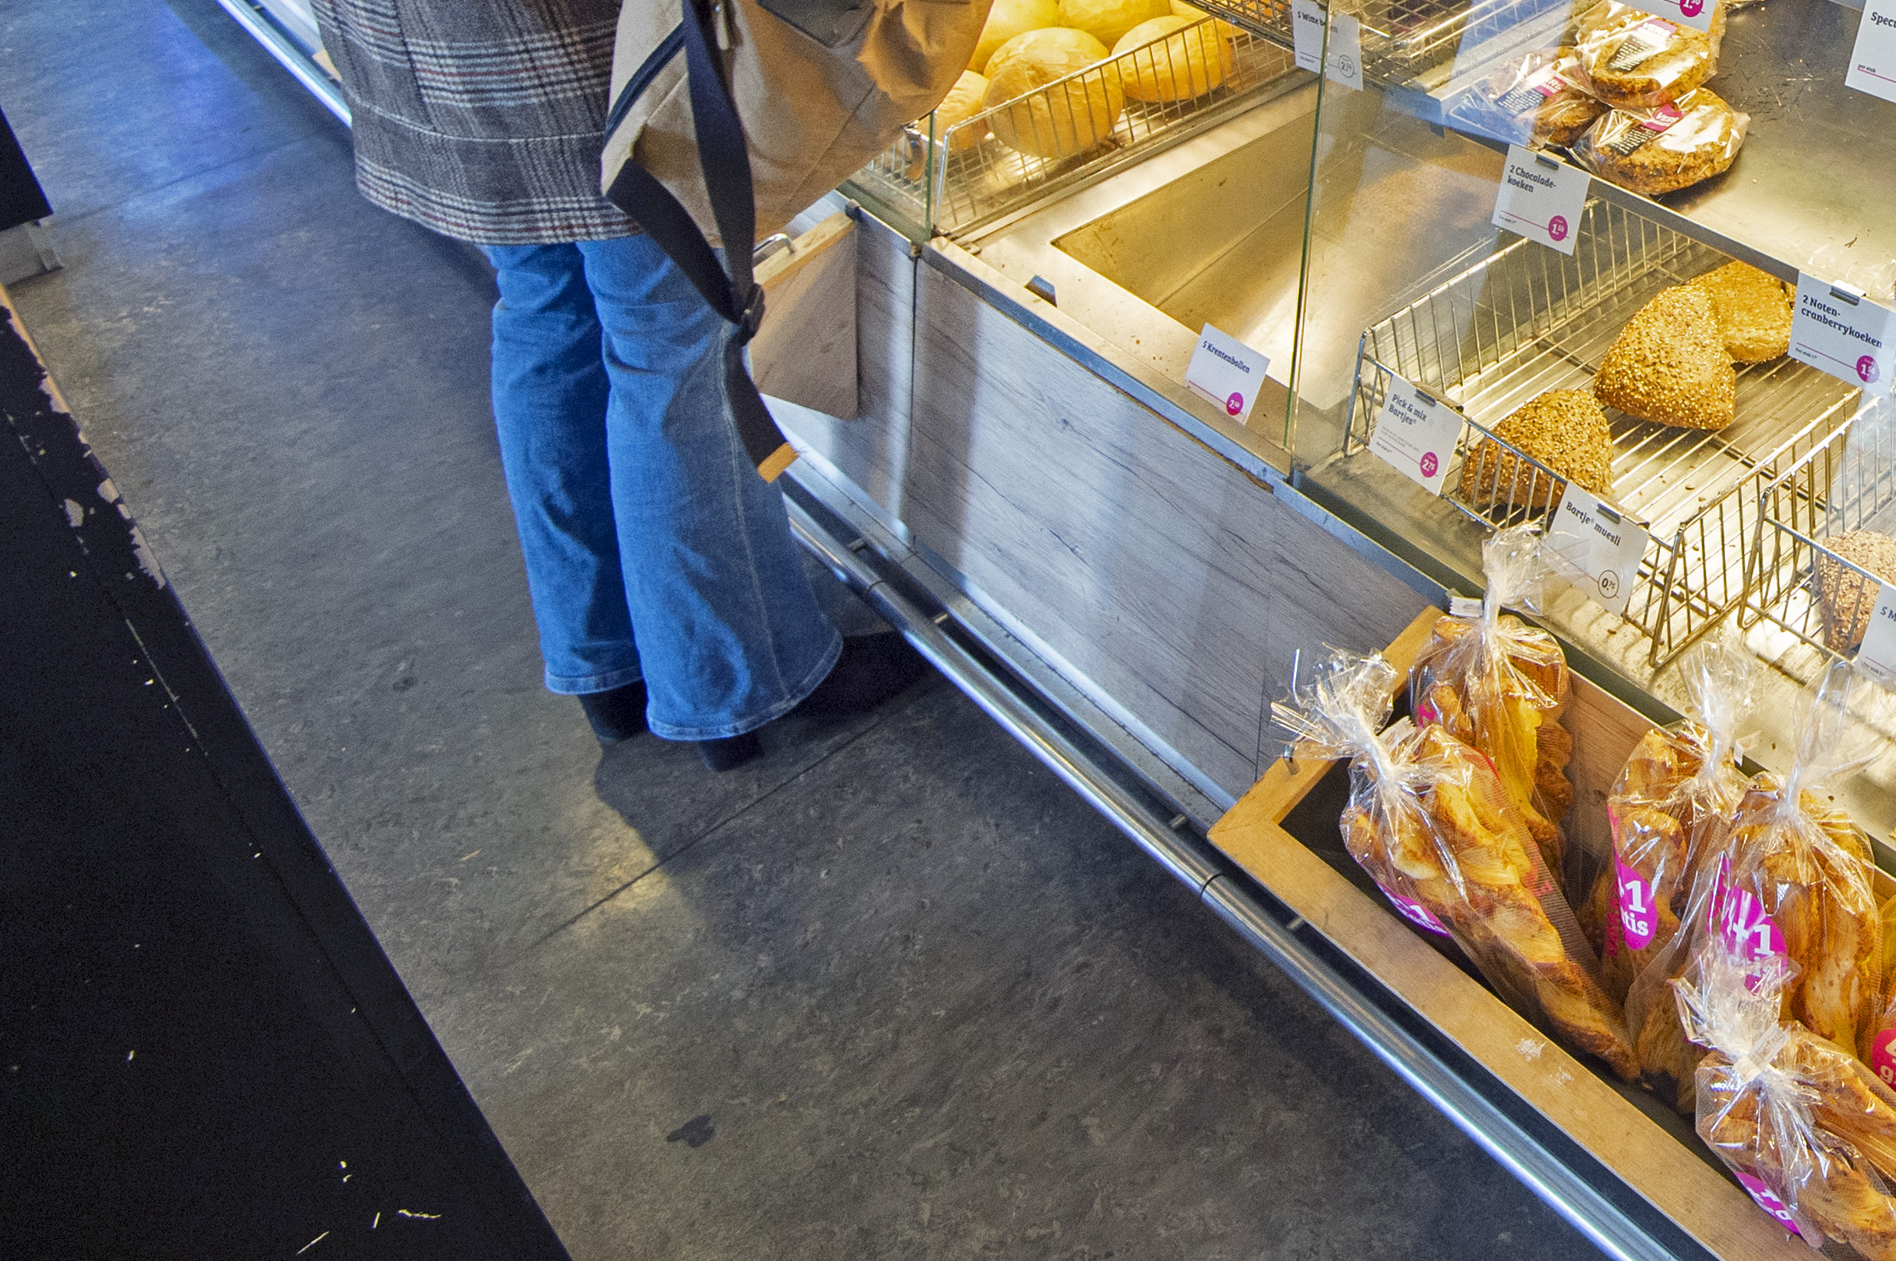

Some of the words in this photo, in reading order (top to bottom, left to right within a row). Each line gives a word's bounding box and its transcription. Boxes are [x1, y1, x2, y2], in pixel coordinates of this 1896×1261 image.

[1302, 12, 1319, 26] Witte
[1507, 175, 1534, 193] koeken
[1509, 164, 1515, 173] 2
[1515, 166, 1557, 189] Chocolade-
[1803, 294, 1809, 304] 2
[1809, 297, 1841, 317] Noten-
[1801, 307, 1883, 349] cranberrykoeken
[1202, 340, 1208, 348] 5
[1207, 342, 1251, 374] Krentenbollen
[1391, 393, 1407, 409] Pick
[1407, 404, 1414, 412] &
[1413, 409, 1428, 422] mix
[1593, 522, 1622, 547] muesli
[1880, 605, 1888, 616] 5
